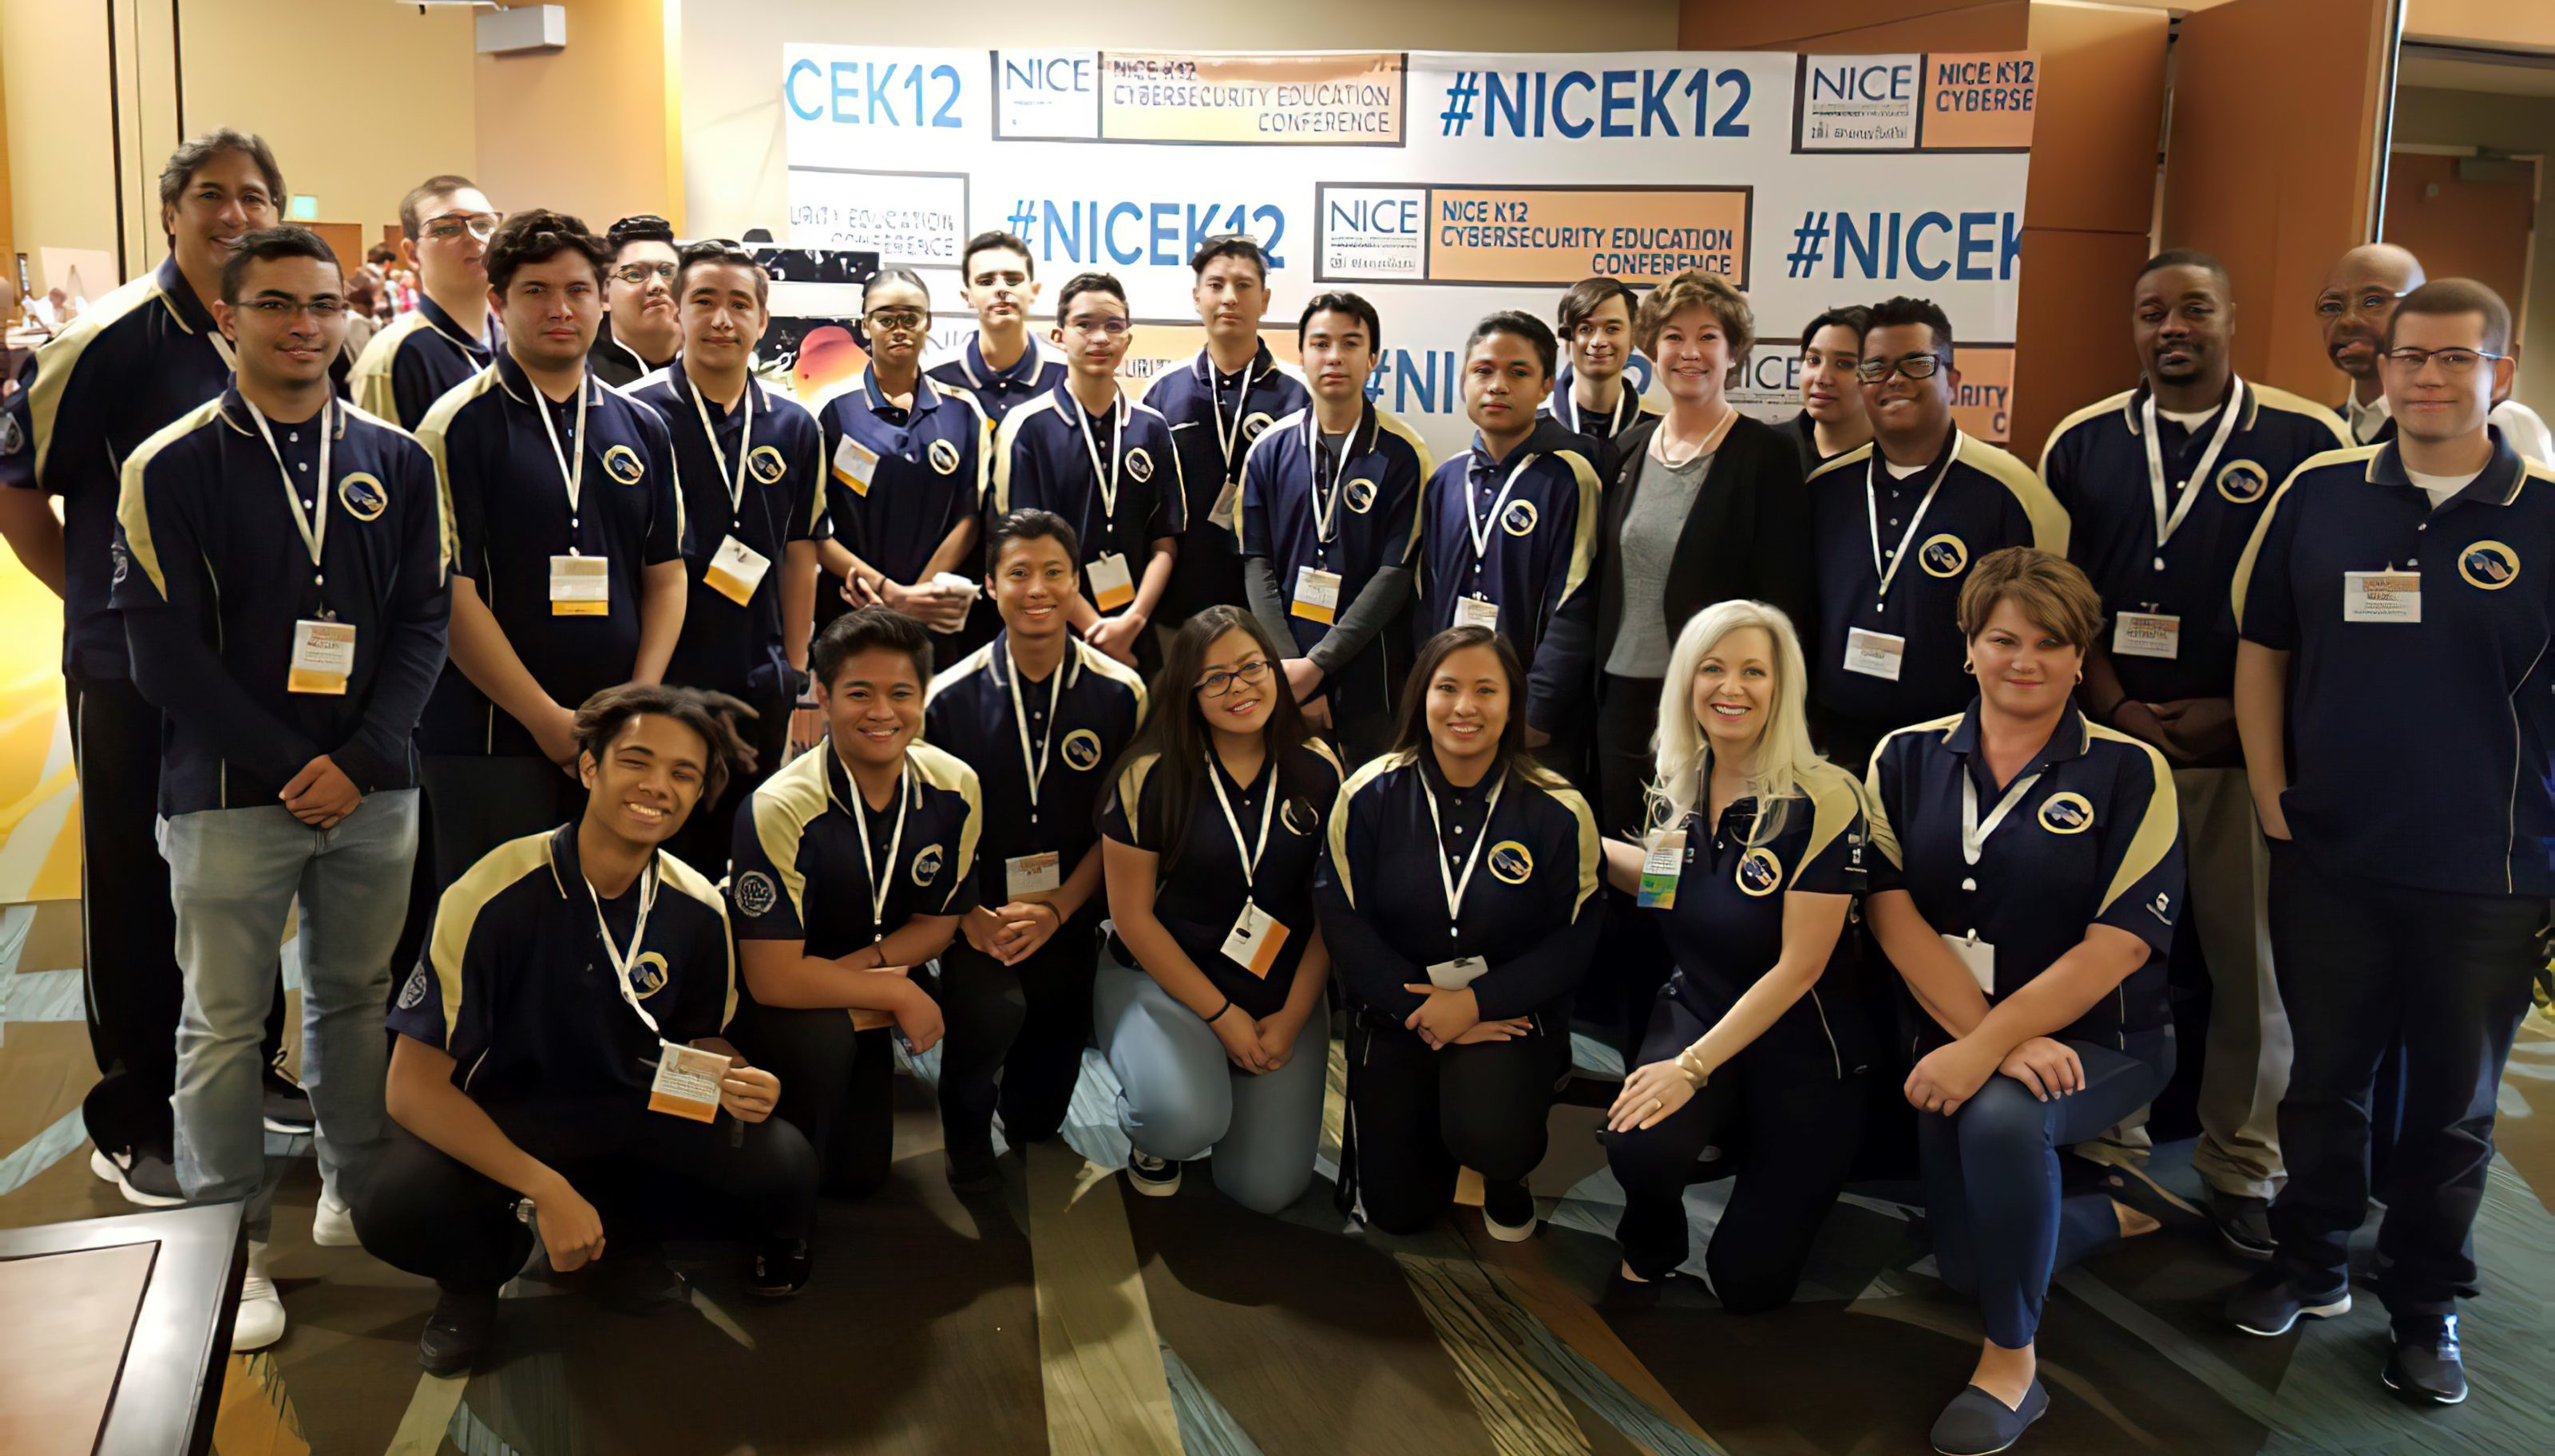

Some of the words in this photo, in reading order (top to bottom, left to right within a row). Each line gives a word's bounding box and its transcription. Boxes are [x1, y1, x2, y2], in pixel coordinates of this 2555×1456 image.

[1007, 58, 1091, 92] NICE
[1812, 65, 1912, 101] NICE
[1939, 62, 1991, 85] NICE
[1997, 61, 2034, 84] K12
[785, 59, 962, 128] CEK12
[1114, 85, 1271, 107] CYBERSECURITY
[1278, 85, 1391, 107] EDUCATION
[1440, 68, 1751, 138] #NICEK12
[1936, 89, 2034, 112] CYBERSE
[1259, 112, 1391, 133] CONFERENCE
[1331, 200, 1418, 233] NICE
[1443, 201, 1488, 222] NICE
[1495, 201, 1528, 222] K12
[1441, 226, 1605, 248] CYBERSECURITY
[1612, 228, 1732, 251] EDUCATION
[1593, 253, 1731, 275] CONFERENCE
